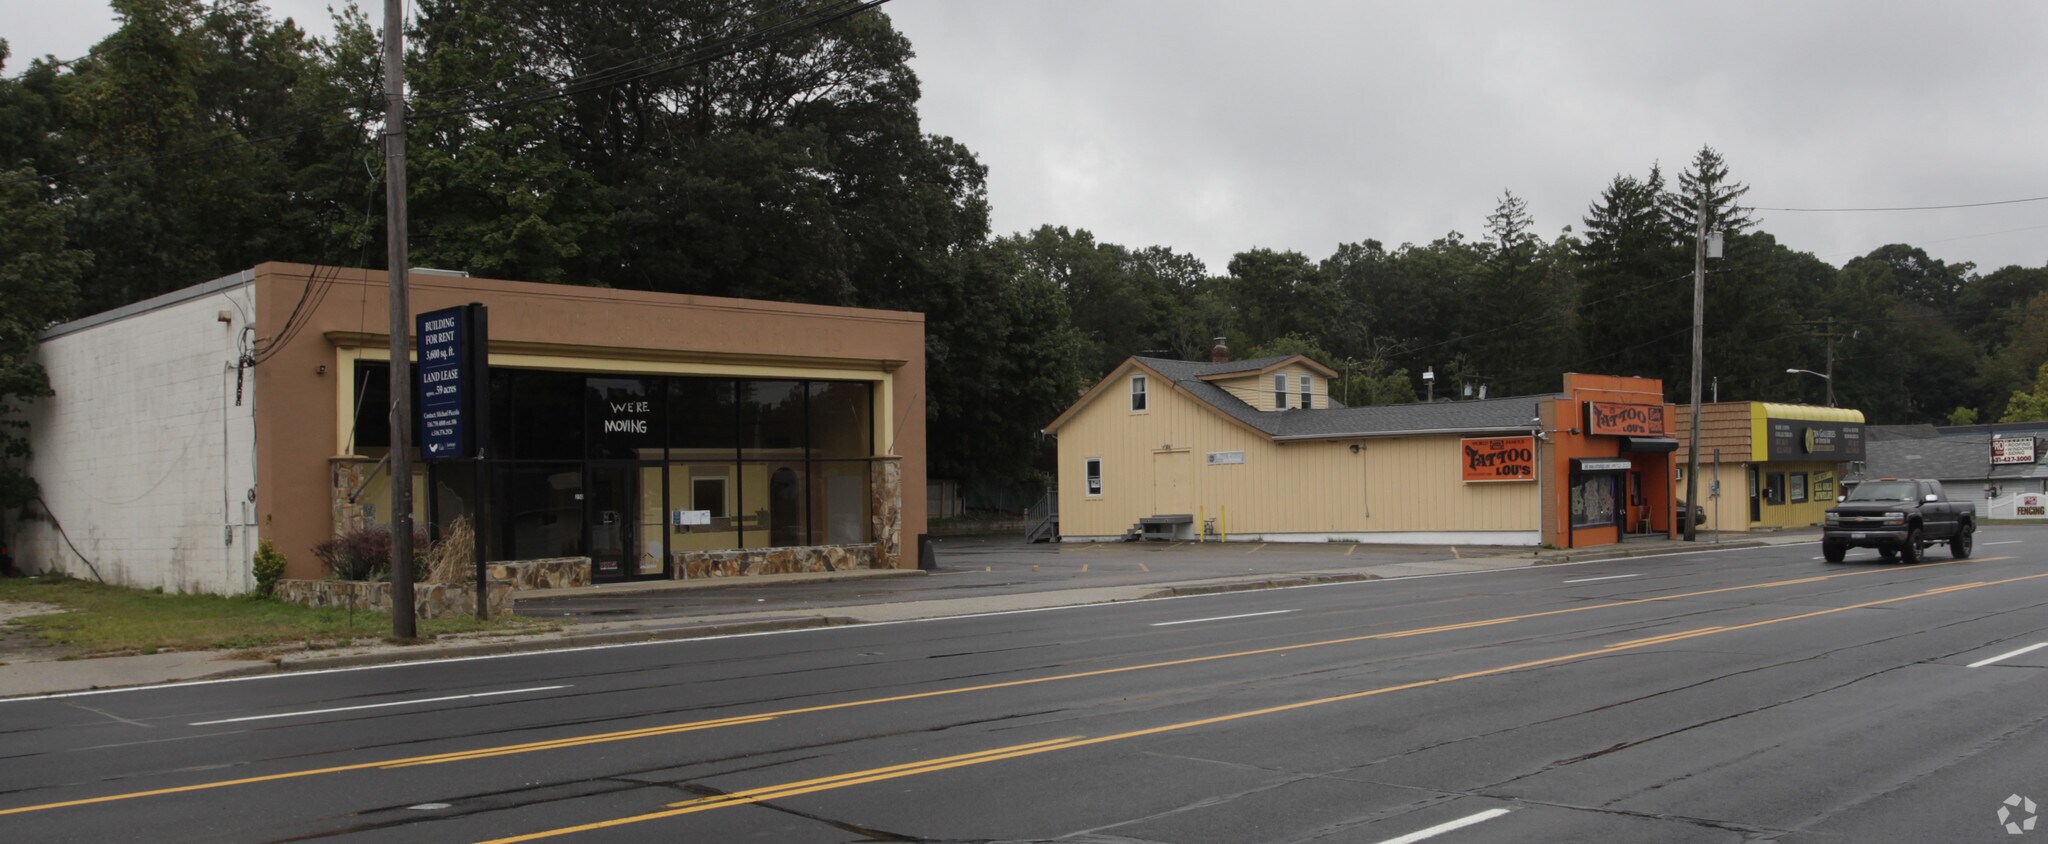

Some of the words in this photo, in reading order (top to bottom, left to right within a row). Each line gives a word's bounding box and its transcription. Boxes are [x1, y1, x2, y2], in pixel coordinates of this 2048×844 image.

[425, 317, 455, 331] BUILDING
[426, 334, 438, 345] FOR
[439, 331, 454, 343] RENT
[426, 349, 440, 360] 3,600
[424, 372, 440, 383] LAND
[441, 369, 459, 380] LEASE
[444, 386, 457, 394] acres
[610, 401, 650, 413] WE'RE
[1592, 405, 1647, 429] TATTOO
[605, 419, 647, 434] MOVING
[1623, 424, 1646, 433] LOU'S
[1465, 445, 1532, 471] TATTOO
[1992, 455, 2032, 463] 31-427-3000
[1496, 465, 1531, 476] LOU'S
[2017, 506, 2045, 515] FENCING
